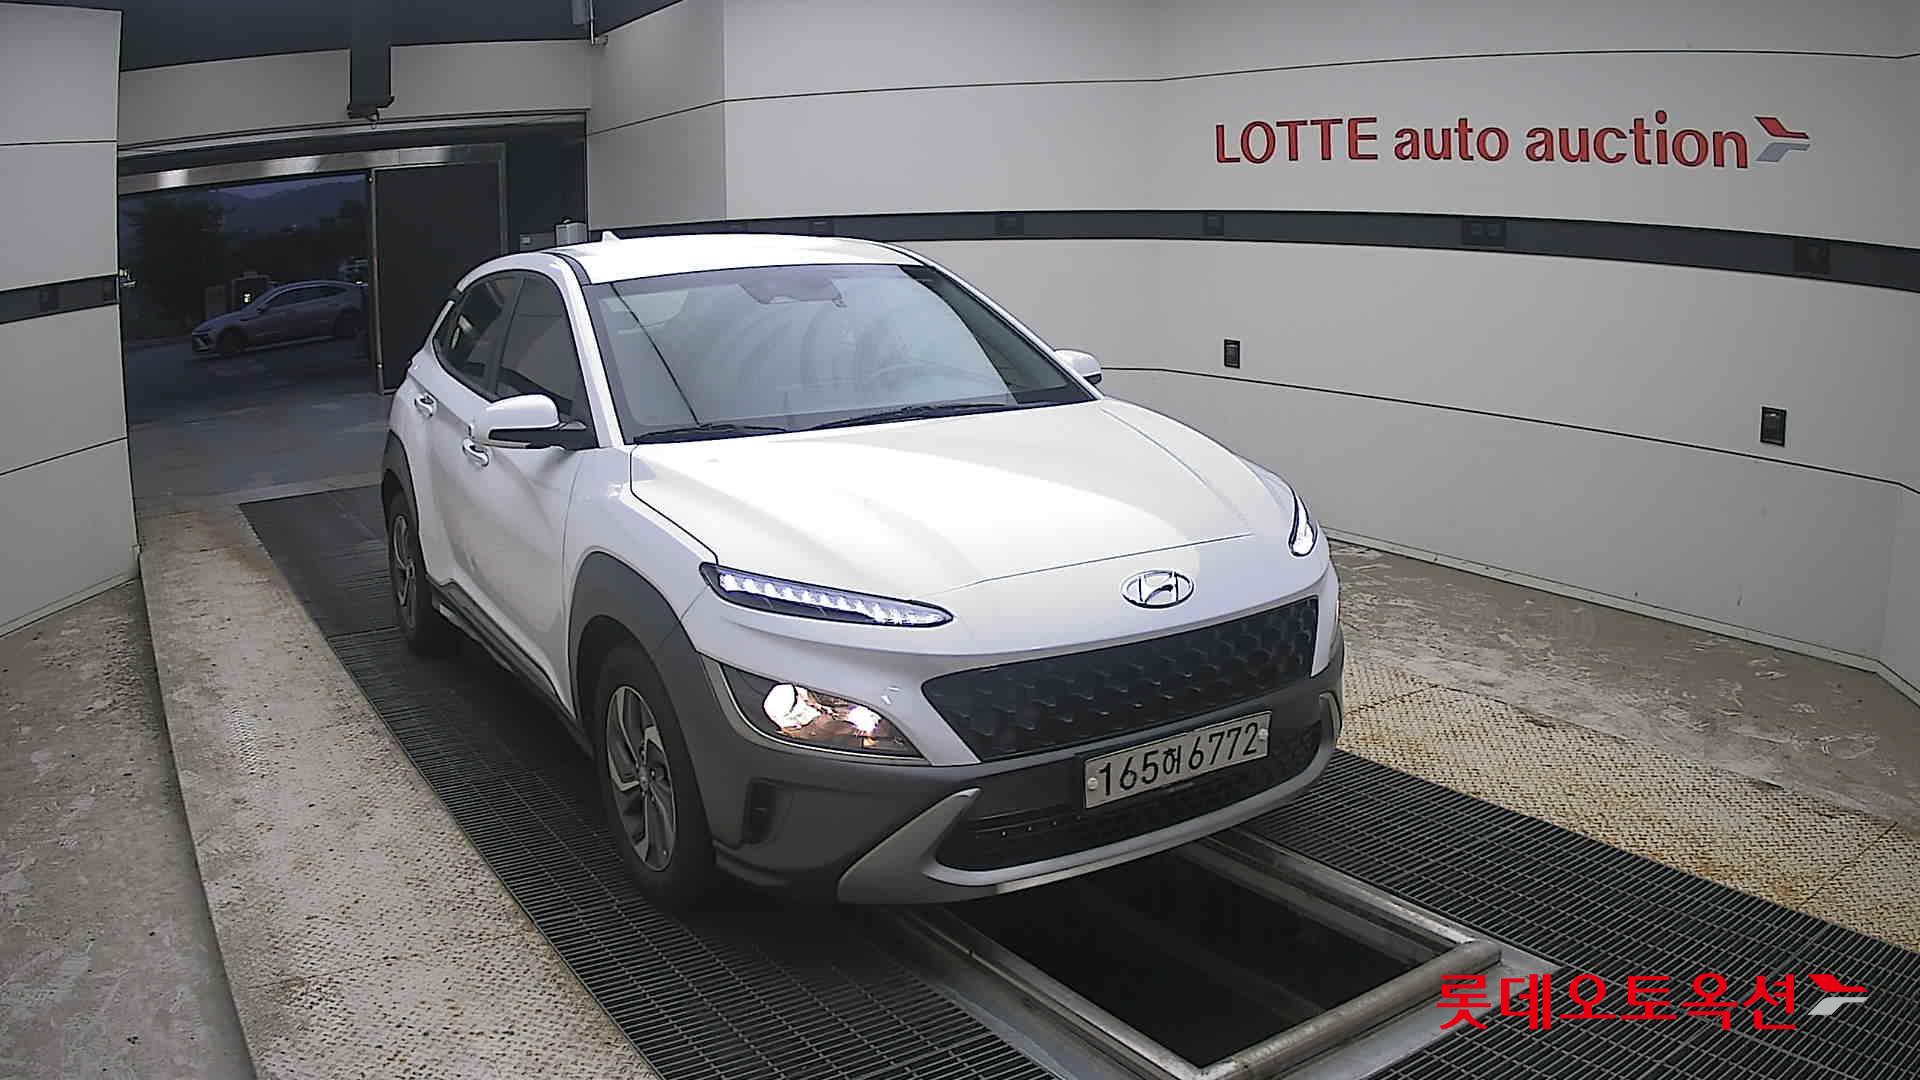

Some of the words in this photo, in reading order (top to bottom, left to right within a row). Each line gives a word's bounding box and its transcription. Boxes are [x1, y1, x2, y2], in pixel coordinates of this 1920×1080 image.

[1215, 117, 1379, 163] LOTTE
[1394, 118, 1510, 161] auto
[1525, 110, 1749, 169] auction
[1099, 721, 1259, 796] 165허6772
